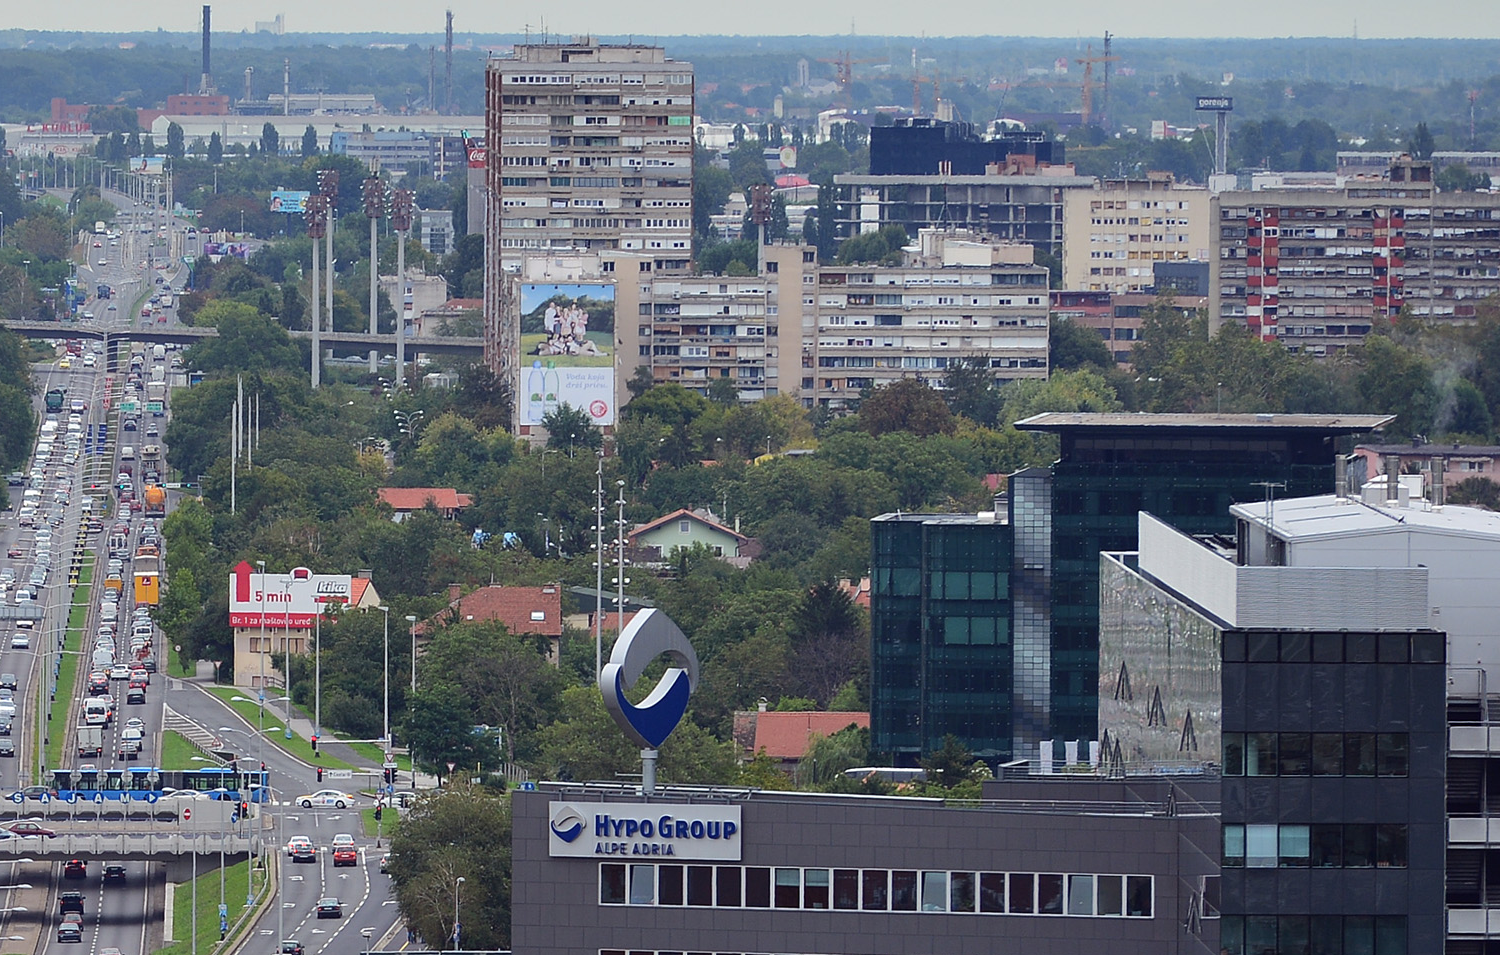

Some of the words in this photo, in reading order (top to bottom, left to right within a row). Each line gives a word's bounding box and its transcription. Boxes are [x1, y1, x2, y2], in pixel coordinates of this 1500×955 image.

[1199, 99, 1228, 108] gorenje
[317, 581, 348, 593] kika
[255, 590, 263, 602] 5
[266, 592, 292, 603] min
[595, 842, 628, 855] ALPE
[632, 843, 675, 856] ADRIA
